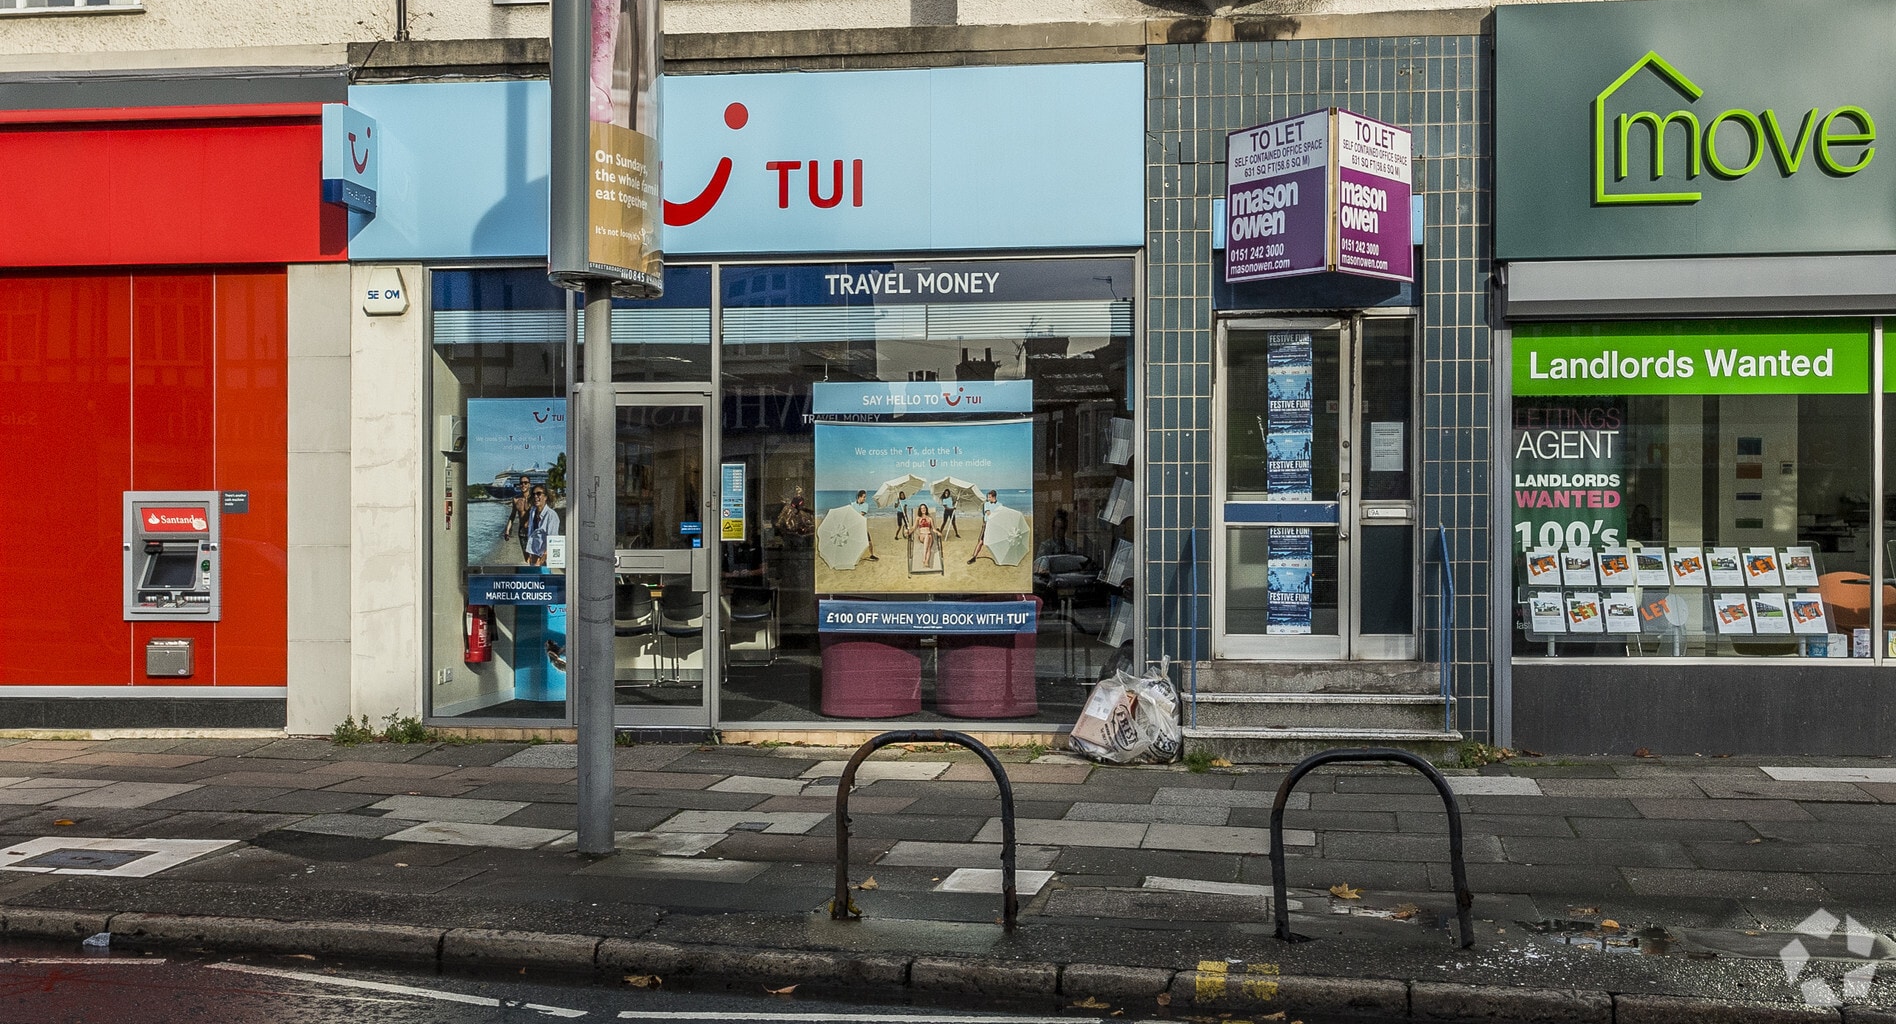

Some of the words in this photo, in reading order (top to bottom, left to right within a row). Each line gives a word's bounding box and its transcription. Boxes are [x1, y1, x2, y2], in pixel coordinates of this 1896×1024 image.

[1250, 130, 1270, 152] TO
[1276, 121, 1305, 146] LET
[1355, 121, 1371, 143] TO
[1374, 130, 1395, 150] LET
[1616, 105, 1875, 177] move
[1235, 156, 1249, 167] SELF
[1249, 149, 1281, 164] CONTAINED
[1282, 143, 1303, 157] OFFICE
[1303, 139, 1322, 152] SPACE
[1343, 139, 1354, 150] SELF
[1354, 142, 1379, 158] CONTAINED
[1379, 151, 1394, 161] OFFICE
[1394, 155, 1407, 166] SPACE
[595, 150, 613, 164] On
[616, 154, 648, 177] Sundays,
[1245, 167, 1255, 178] 631
[1257, 165, 1266, 176] SQ
[1291, 157, 1302, 169] SQ
[1352, 155, 1360, 165] 631
[1361, 158, 1369, 169] SQ
[1387, 165, 1394, 176] SQ
[595, 169, 615, 182] the
[618, 174, 640, 190] whole
[642, 179, 659, 196] famil
[766, 159, 863, 209] TUI
[596, 189, 615, 201] eat
[619, 192, 648, 210] together
[1232, 181, 1298, 216] mason
[1342, 180, 1387, 212] mason
[1232, 210, 1285, 241] owen
[1342, 204, 1378, 234] owen
[596, 225, 606, 235] It's
[608, 229, 618, 237] not
[1231, 247, 1248, 262] 0151
[1250, 246, 1264, 260] 242
[1265, 244, 1284, 258] 3000
[1342, 238, 1354, 250] 0151
[1356, 241, 1365, 254] 242
[1366, 244, 1379, 256] 3000
[1231, 258, 1290, 275] masonowen.com
[1342, 252, 1388, 270] masonowen.com
[629, 270, 645, 282] 0845
[825, 273, 911, 296] TRAVEL
[917, 273, 1000, 295] MONEY
[1270, 334, 1294, 342] FESTIVE
[1530, 349, 1694, 380] Landlords
[1705, 348, 1834, 378] Wanted
[863, 395, 882, 405] SAY
[887, 395, 920, 405] HELLO
[924, 395, 938, 404] TO
[966, 396, 981, 404] TUI
[1271, 401, 1295, 409] FESTIVE
[1296, 400, 1310, 409] FUN!
[1515, 408, 1620, 429] LETTINGS
[1516, 430, 1619, 459] AGENT
[965, 458, 991, 466] middle
[1270, 461, 1294, 470] FESTIVE
[1295, 461, 1309, 469] FUN!
[1516, 474, 1620, 487] LANDLORDS
[1515, 490, 1620, 508] WANTED
[1270, 528, 1295, 536] FESTIVE
[1515, 520, 1620, 552] 100's
[1529, 555, 1558, 576] LET
[1600, 556, 1629, 576] LET
[1673, 556, 1702, 578] LET
[1746, 556, 1776, 577] LET
[493, 581, 545, 589] INTRODUCING
[486, 592, 519, 600] MARELLA
[521, 592, 552, 600] CRUISES
[1295, 593, 1309, 601] FUN!
[827, 613, 853, 623] £100
[857, 613, 878, 623] OFF
[882, 614, 914, 624] WHEN
[916, 614, 939, 624] YOU
[942, 614, 973, 625] BOOK
[976, 613, 1003, 624] WITH
[1569, 602, 1598, 623] LET
[1641, 599, 1670, 621] LET
[1719, 603, 1748, 624] LET
[1793, 602, 1823, 624] LET
